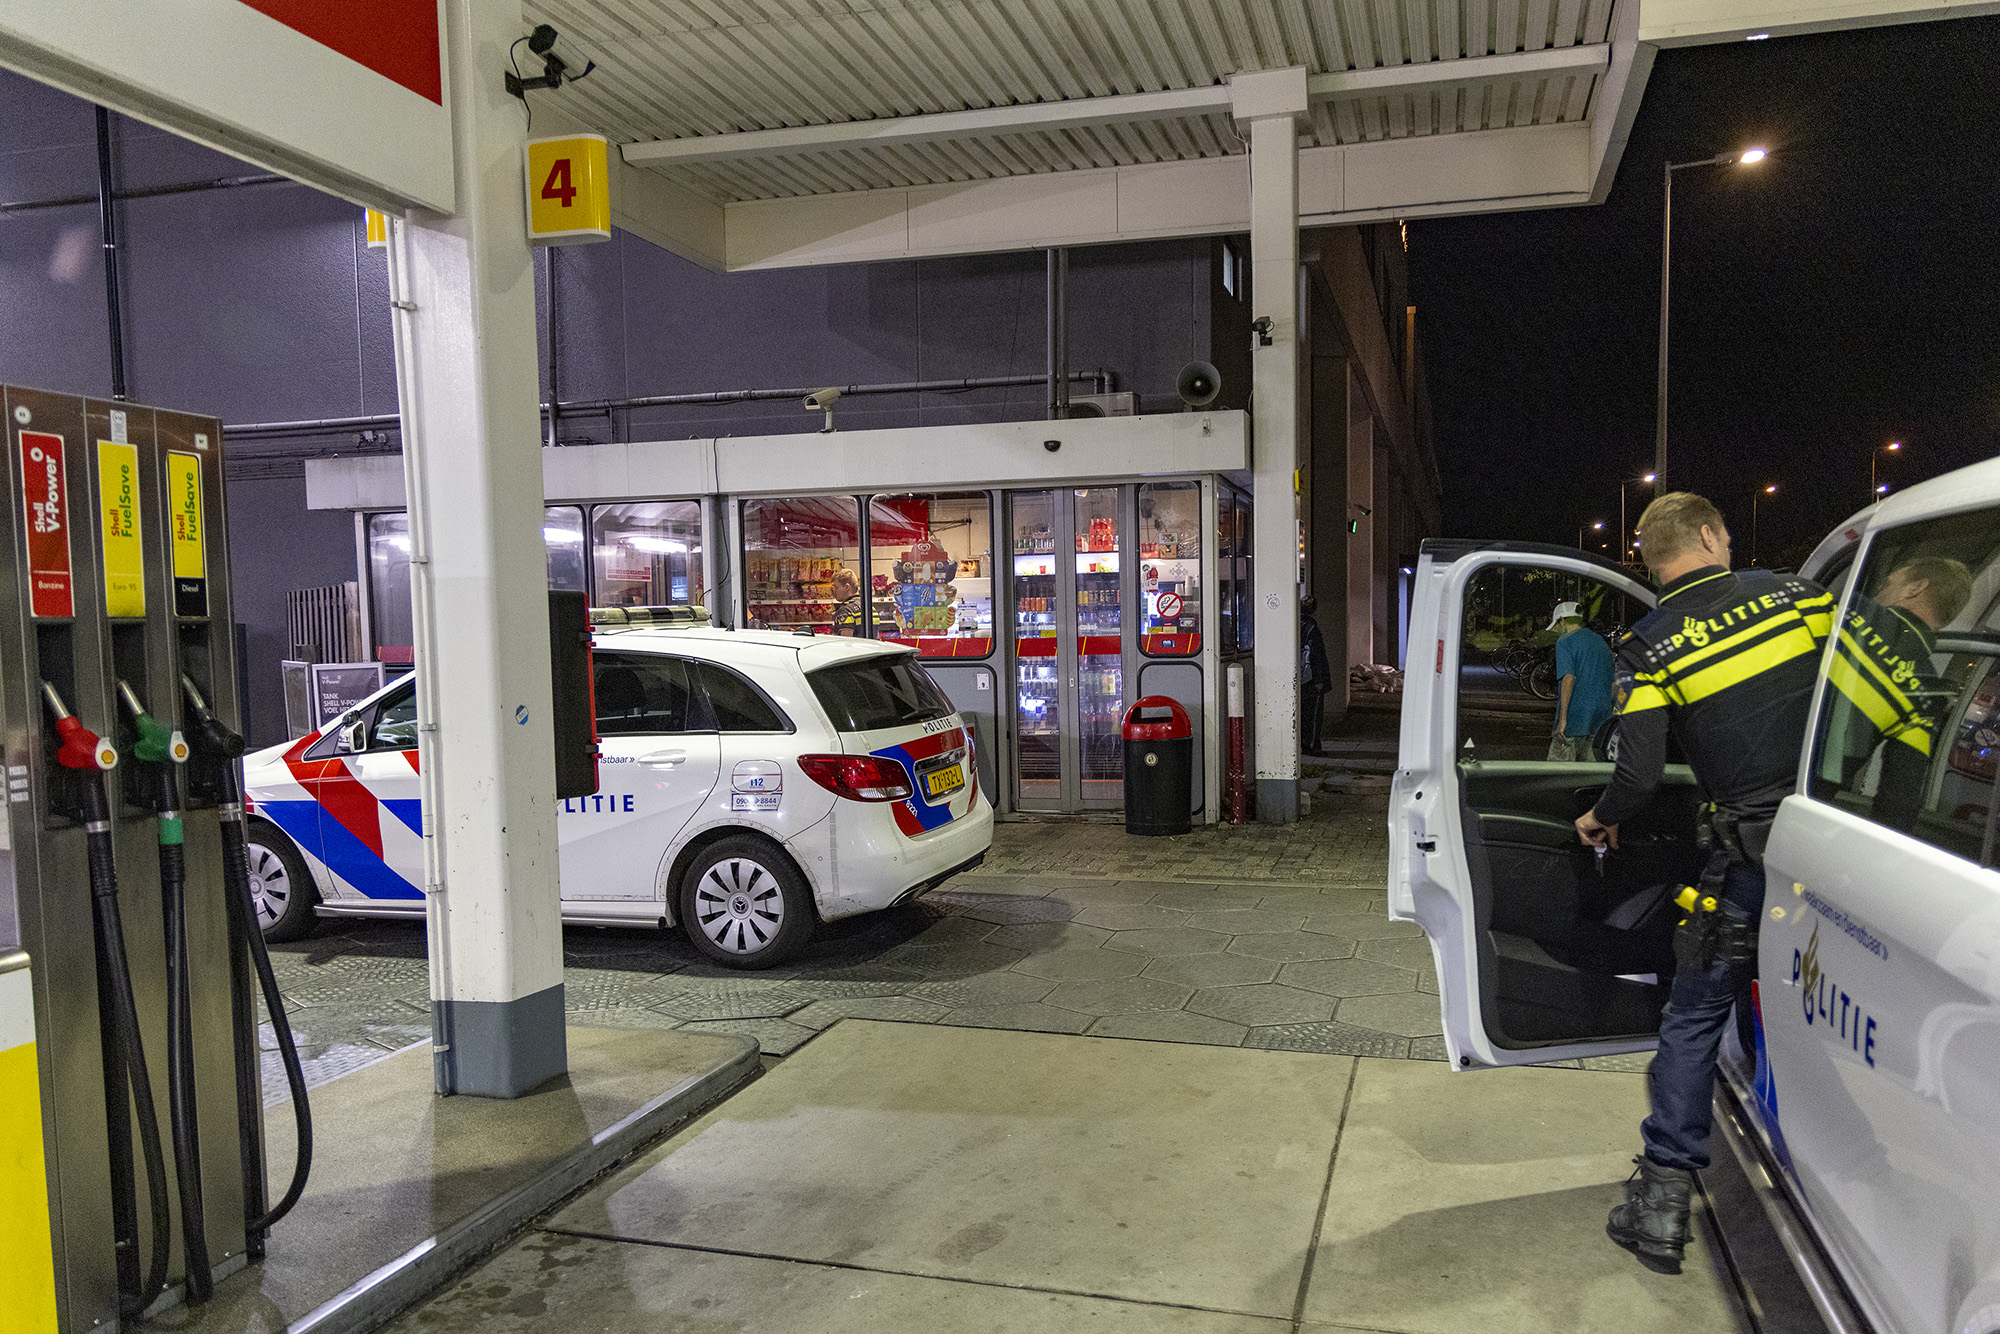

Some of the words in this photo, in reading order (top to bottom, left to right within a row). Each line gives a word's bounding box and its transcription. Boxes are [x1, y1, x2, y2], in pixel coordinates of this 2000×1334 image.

[541, 158, 577, 208] 4
[45, 454, 61, 533] V-Power
[118, 464, 133, 538] FuelSave
[32, 502, 46, 533] Shell
[184, 472, 197, 542] FuelSave
[109, 508, 119, 537] Shell
[175, 514, 186, 541] Shell
[37, 581, 65, 590] Benzine
[128, 583, 138, 592] 95
[181, 584, 200, 593] Diesel
[1670, 594, 1777, 649] POLITIE
[323, 699, 340, 707] SHELL
[323, 706, 339, 714] VOEL
[923, 718, 953, 734] POLITIE
[932, 768, 960, 791] TX-132-L
[556, 794, 635, 814] LITIE
[760, 797, 777, 805] 8844
[1793, 947, 1877, 1069] POLITIE
